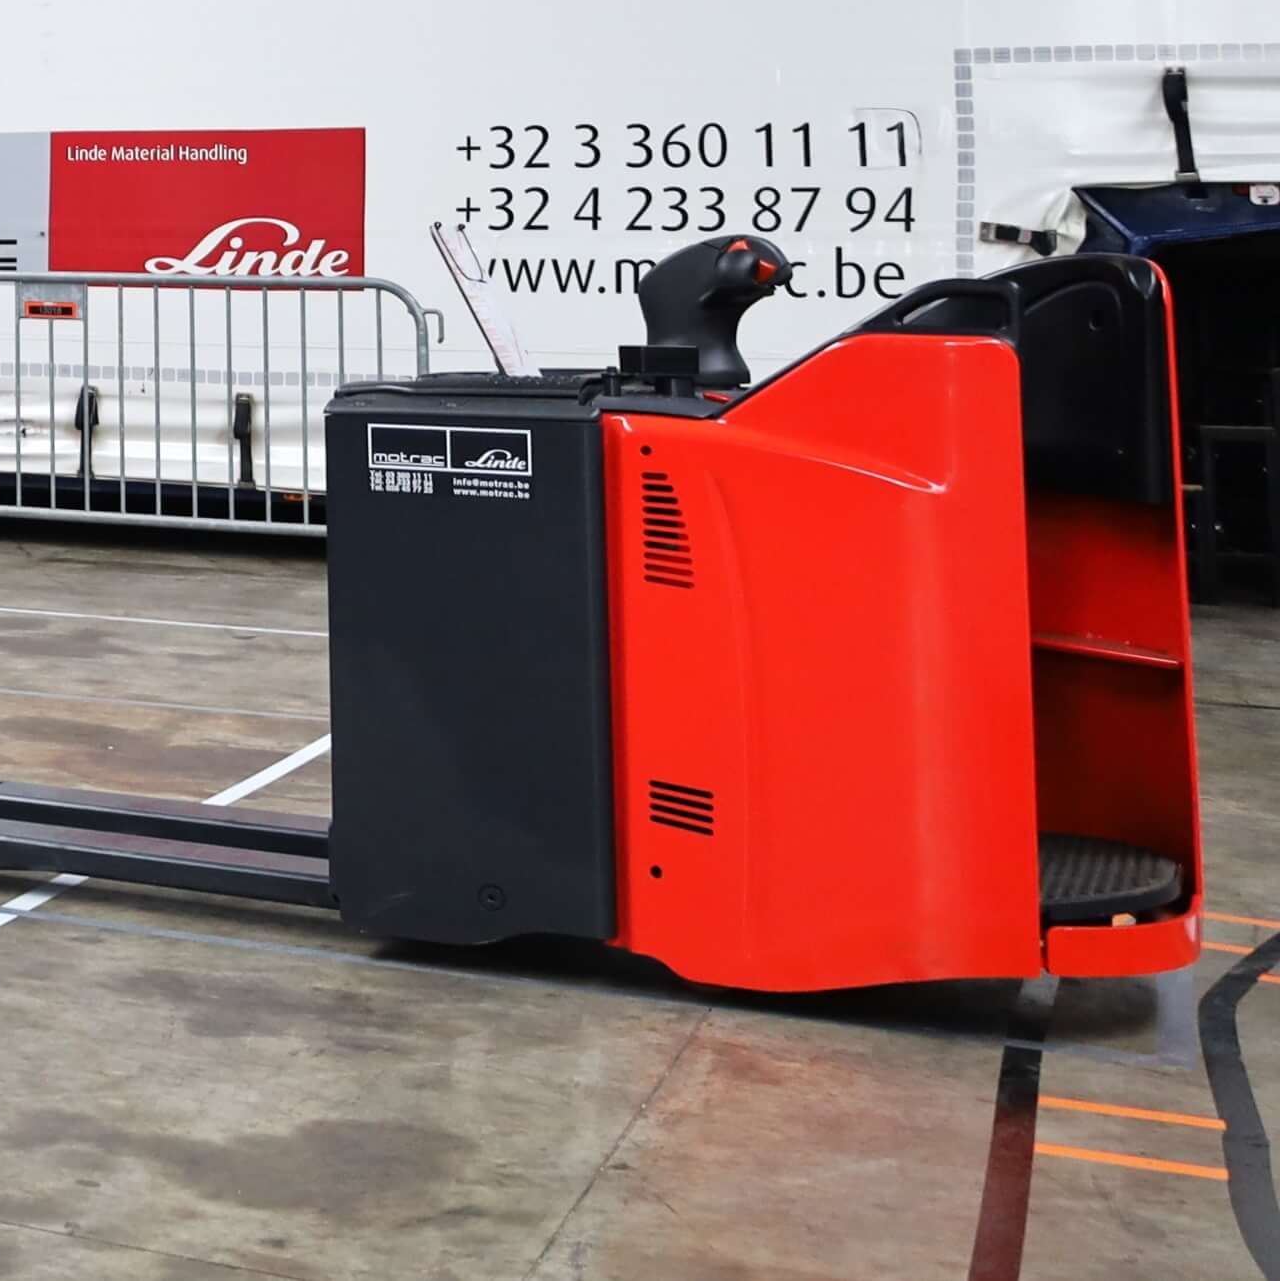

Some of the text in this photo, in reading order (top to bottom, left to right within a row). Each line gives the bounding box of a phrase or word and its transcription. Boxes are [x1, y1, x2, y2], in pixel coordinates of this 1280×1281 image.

[67, 144, 248, 165] Linde Material Handling
[456, 121, 908, 169] +32 3 360 11 11
[455, 187, 915, 232] +32 4 233 87 94
[144, 217, 350, 277] Linde
[373, 451, 445, 466] motrac
[464, 448, 527, 470] Linde
